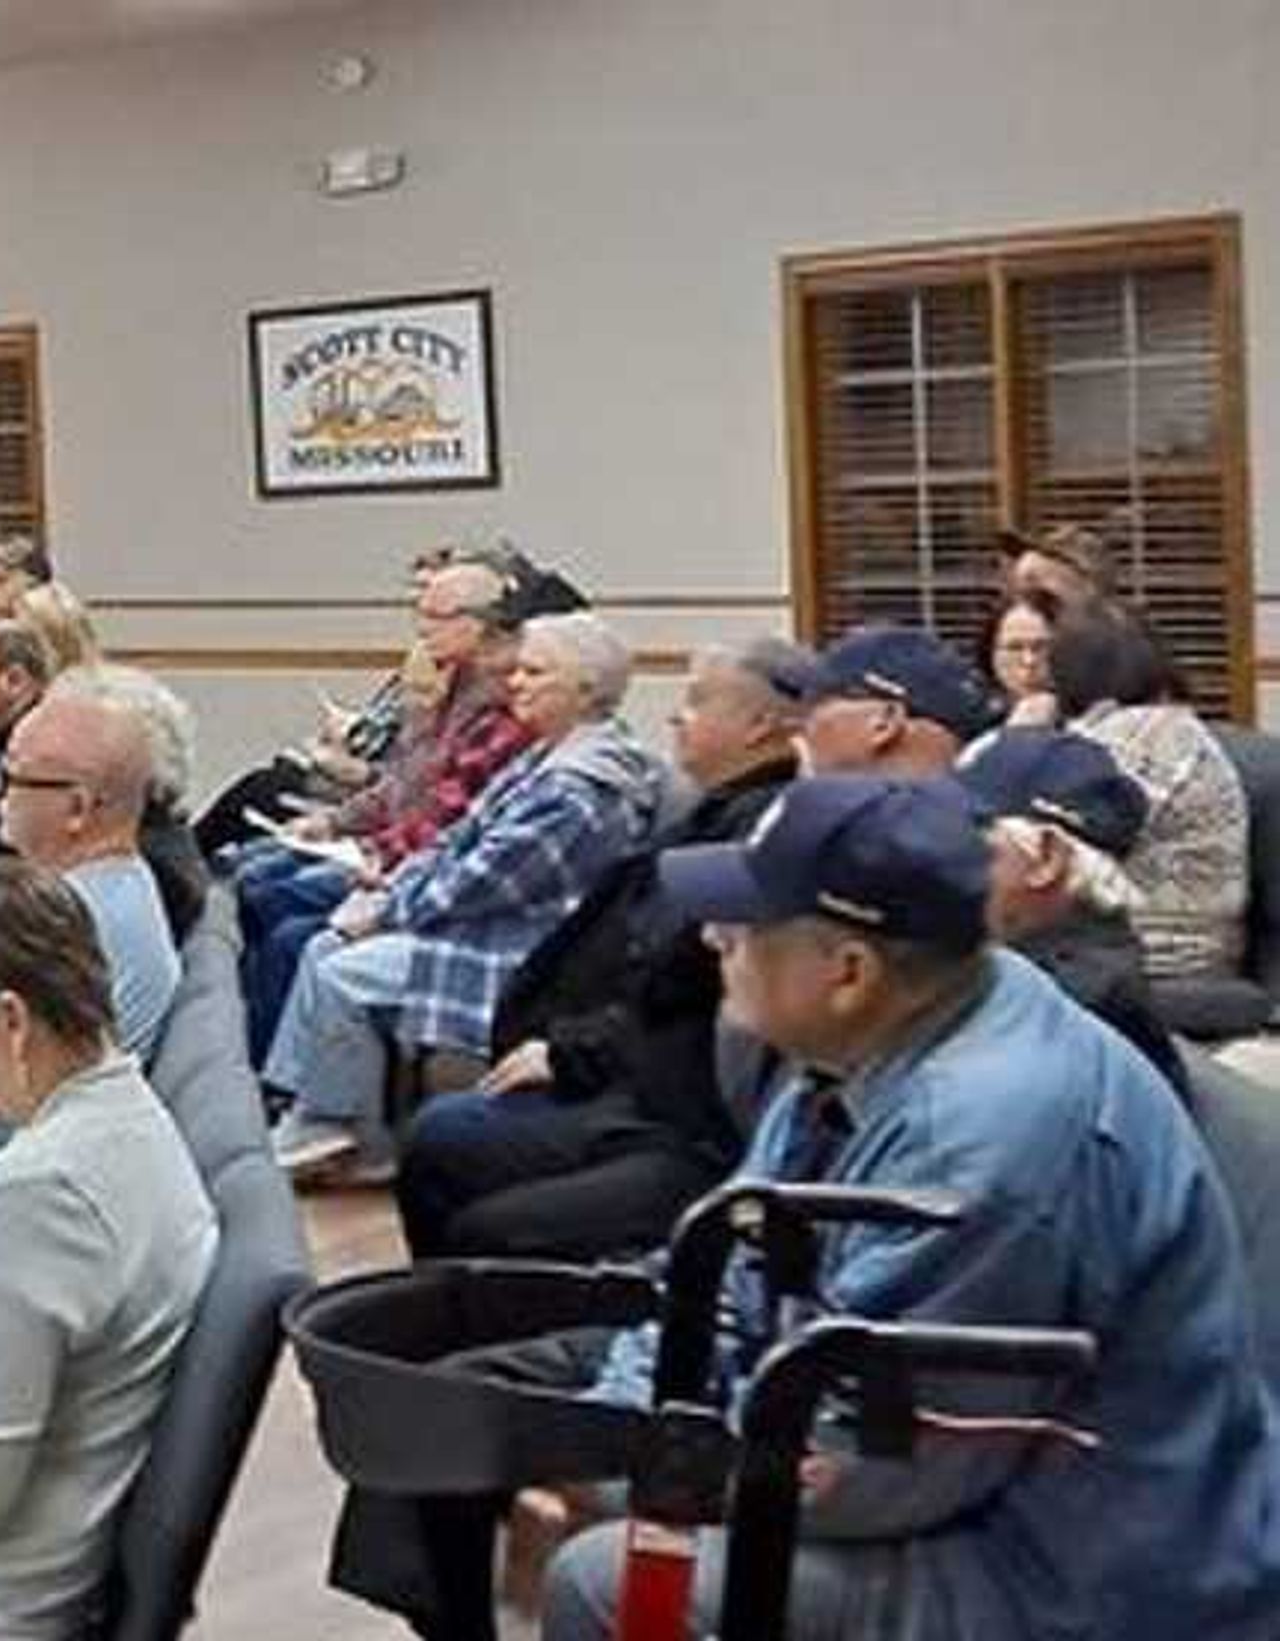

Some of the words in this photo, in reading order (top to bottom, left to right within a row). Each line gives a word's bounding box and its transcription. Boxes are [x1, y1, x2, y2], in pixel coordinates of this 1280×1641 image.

[281, 326, 382, 389] SCOTT
[390, 326, 467, 374] CITY
[291, 438, 462, 466] MISSOURI
